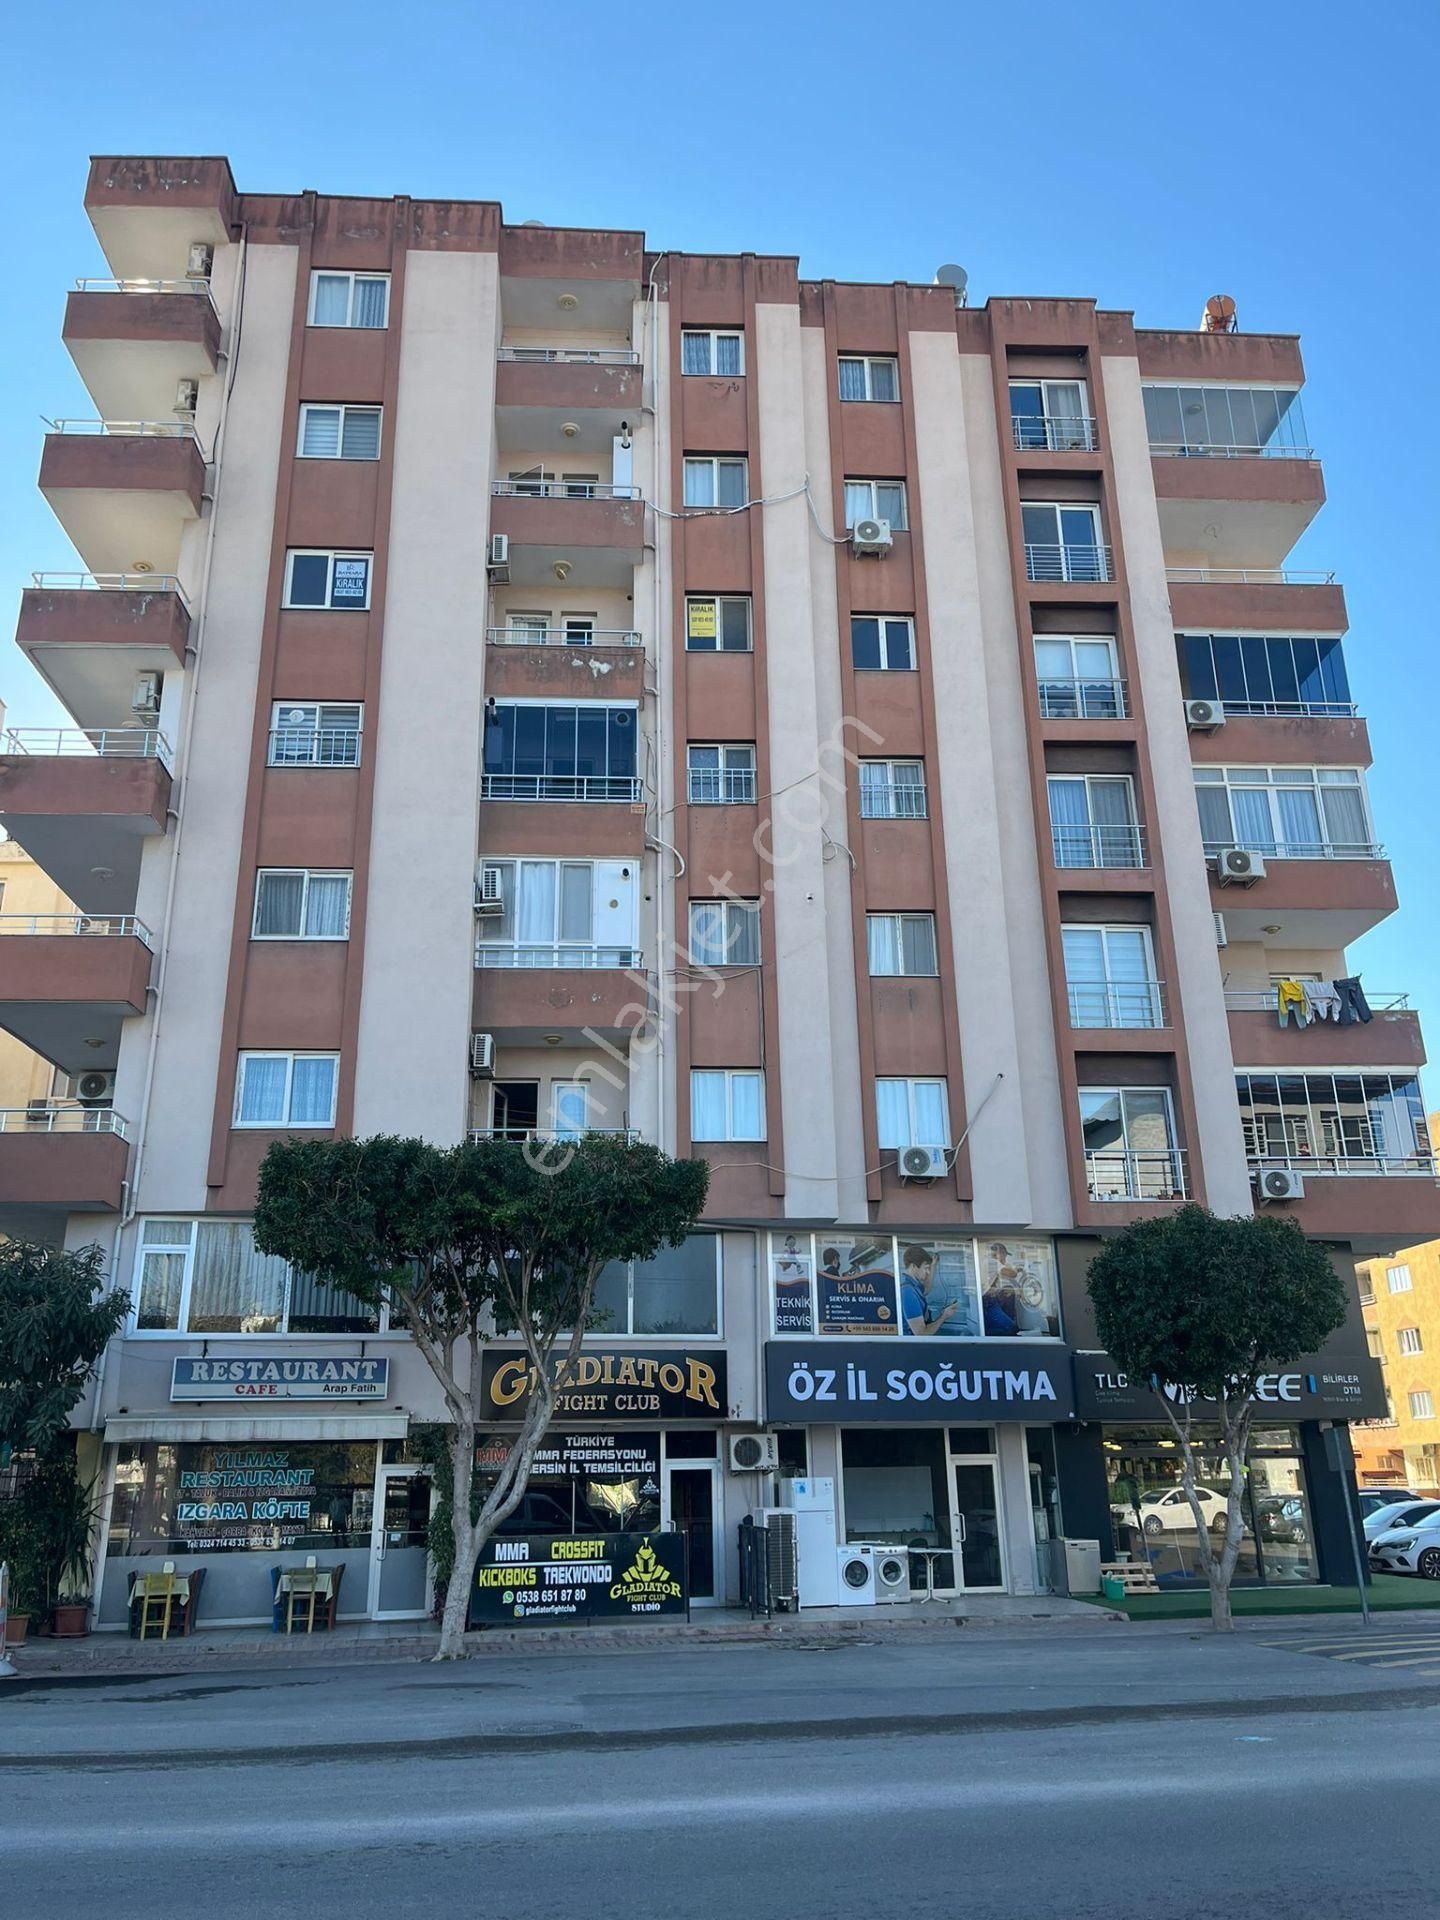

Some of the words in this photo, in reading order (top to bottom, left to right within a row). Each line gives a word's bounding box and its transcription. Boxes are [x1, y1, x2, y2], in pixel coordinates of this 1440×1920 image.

[838, 1281, 875, 1294] KLİMA
[776, 1295, 811, 1308] TEKNİK
[776, 1313, 811, 1326] SERVİS
[190, 1361, 378, 1381] RESTAURANT
[788, 1362, 837, 1401] ÖZ
[847, 1362, 878, 1401] İL
[886, 1362, 1057, 1401] SOĞUTMA
[1095, 1373, 1128, 1388] TLC
[235, 1384, 278, 1395] CAFE
[323, 1384, 348, 1393] Arap
[350, 1383, 377, 1393] Fatih
[1343, 1386, 1360, 1395] DTM
[554, 1395, 608, 1410] FIGHT
[615, 1395, 660, 1410] CLUB
[565, 1434, 615, 1447] TÜRKİYE
[213, 1452, 289, 1468] YILMAZ
[533, 1449, 560, 1460] MMA
[563, 1449, 646, 1460] FEDERASYONU
[530, 1461, 566, 1474] ERSİN
[570, 1461, 580, 1473] İL
[583, 1460, 656, 1473] TEMSİLCİLİĞİ
[181, 1469, 315, 1488] RESTAURANT
[178, 1502, 247, 1520] IZGARA
[252, 1498, 310, 1519] KÖFTE
[200, 1539, 214, 1548] 0324
[495, 1542, 529, 1561] MMA
[551, 1540, 606, 1559] CROSSFIT
[479, 1567, 537, 1587] KICKBOKS
[544, 1565, 612, 1584] TAEKWONDO
[516, 1591, 539, 1603] 0538
[541, 1590, 558, 1602] 651
[561, 1589, 572, 1601] 87
[575, 1588, 586, 1601] 80
[610, 1581, 682, 1600] GLADIATOR
[627, 1594, 647, 1602] FIGHT
[648, 1593, 666, 1601] CLUB
[525, 1604, 577, 1616] gladiatorfightclub
[631, 1602, 661, 1612] STUDİO
